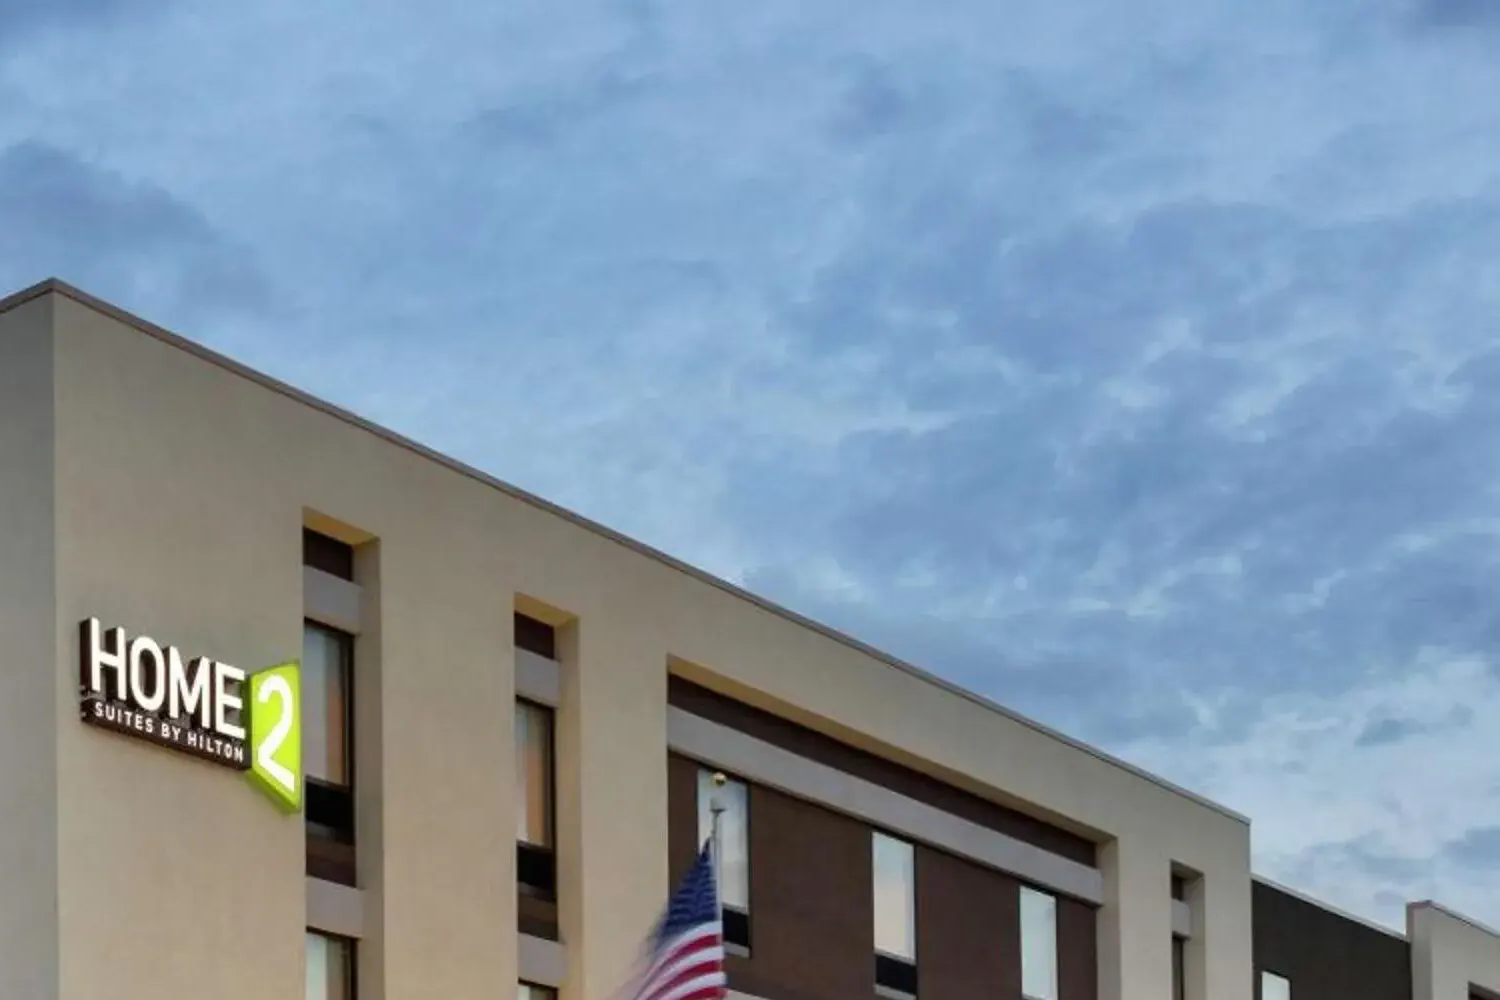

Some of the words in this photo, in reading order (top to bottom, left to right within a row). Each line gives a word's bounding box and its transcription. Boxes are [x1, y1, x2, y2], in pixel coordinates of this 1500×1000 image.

[90, 616, 246, 740] HOME
[257, 674, 296, 793] 2
[95, 701, 154, 733] SUITES
[161, 722, 181, 741] BY
[187, 731, 245, 763] HILTON
